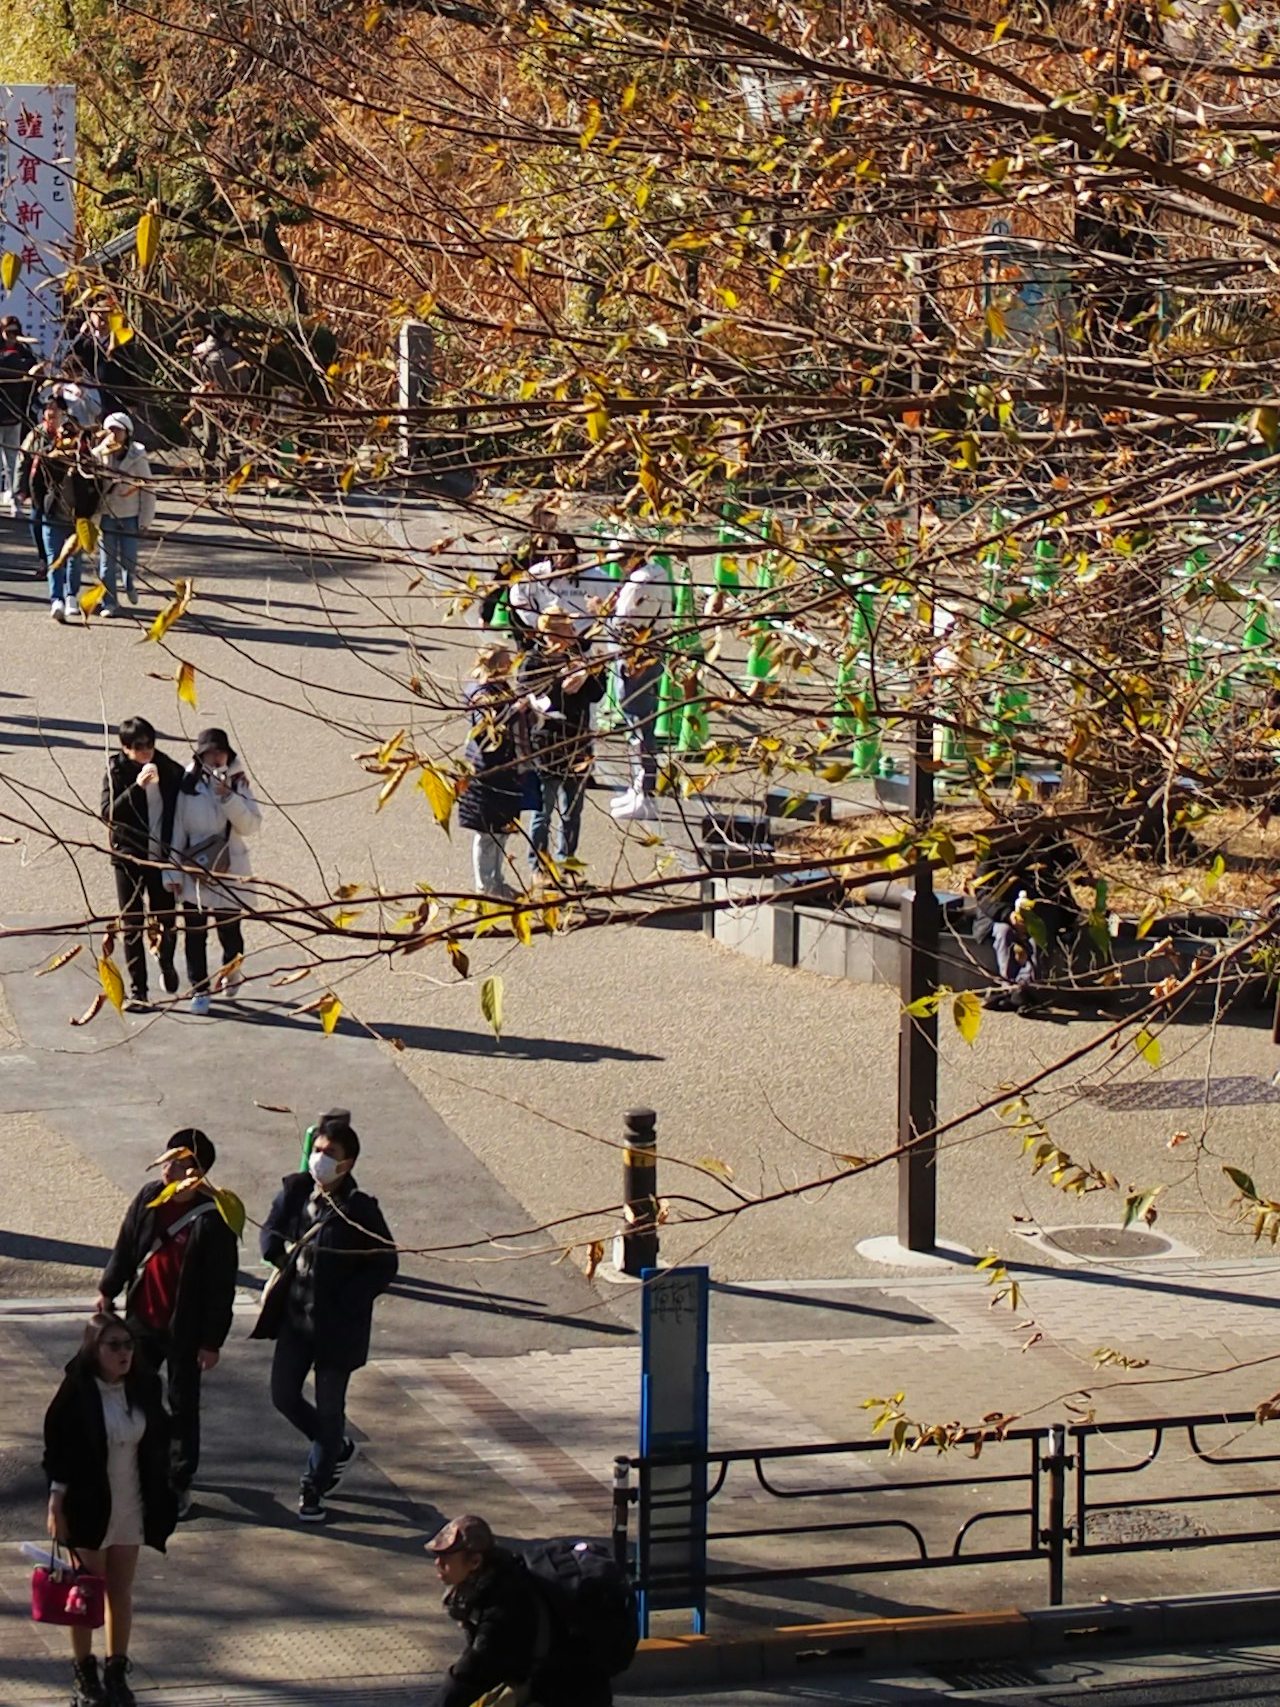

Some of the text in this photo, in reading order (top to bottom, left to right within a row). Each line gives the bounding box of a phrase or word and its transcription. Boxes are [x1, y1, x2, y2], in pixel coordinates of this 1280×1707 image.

[14, 109, 45, 275] 謹賀新年
[52, 175, 64, 202] 乙巳
